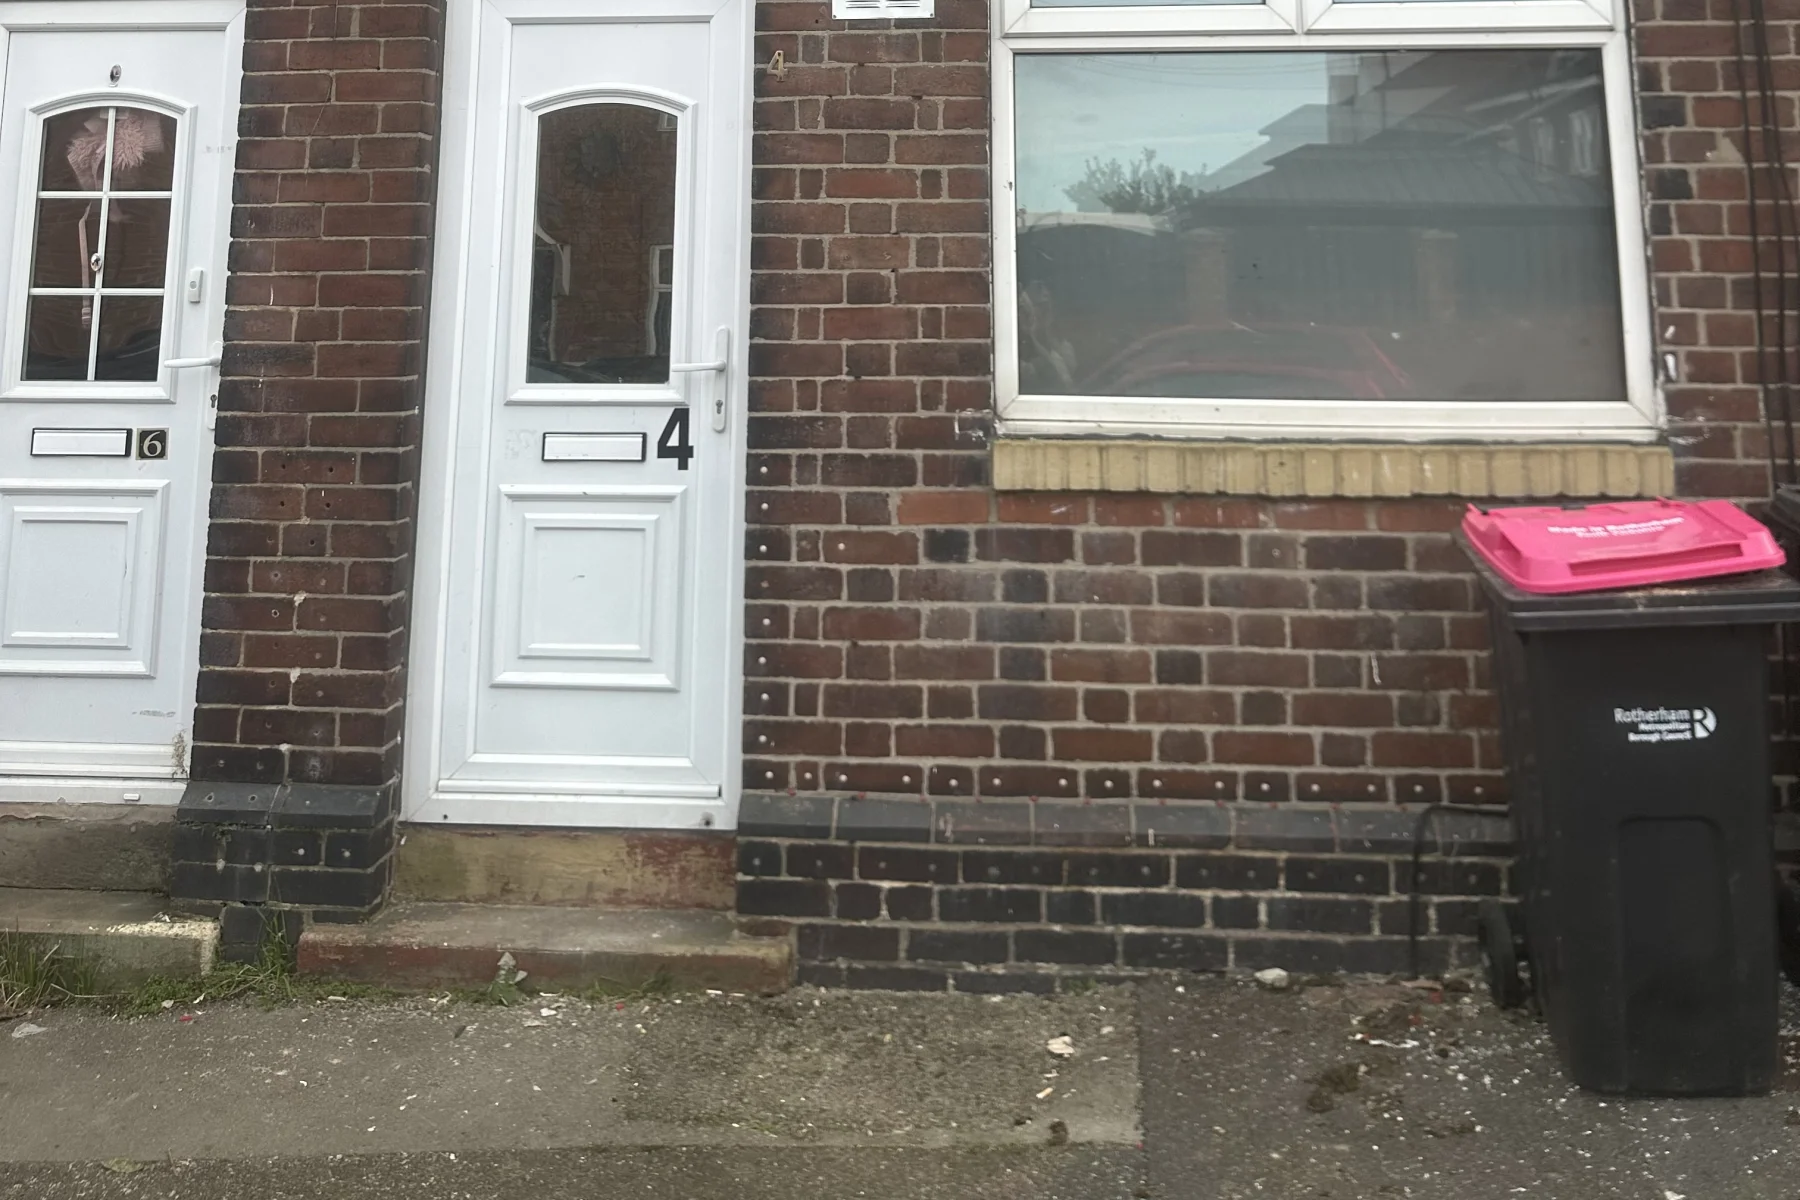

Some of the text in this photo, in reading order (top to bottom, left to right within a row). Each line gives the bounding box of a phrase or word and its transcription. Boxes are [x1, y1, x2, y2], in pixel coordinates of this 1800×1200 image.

[767, 50, 788, 82] 4
[143, 431, 162, 457] 6
[657, 407, 694, 471] 4
[1614, 707, 1691, 723] Rotherham
